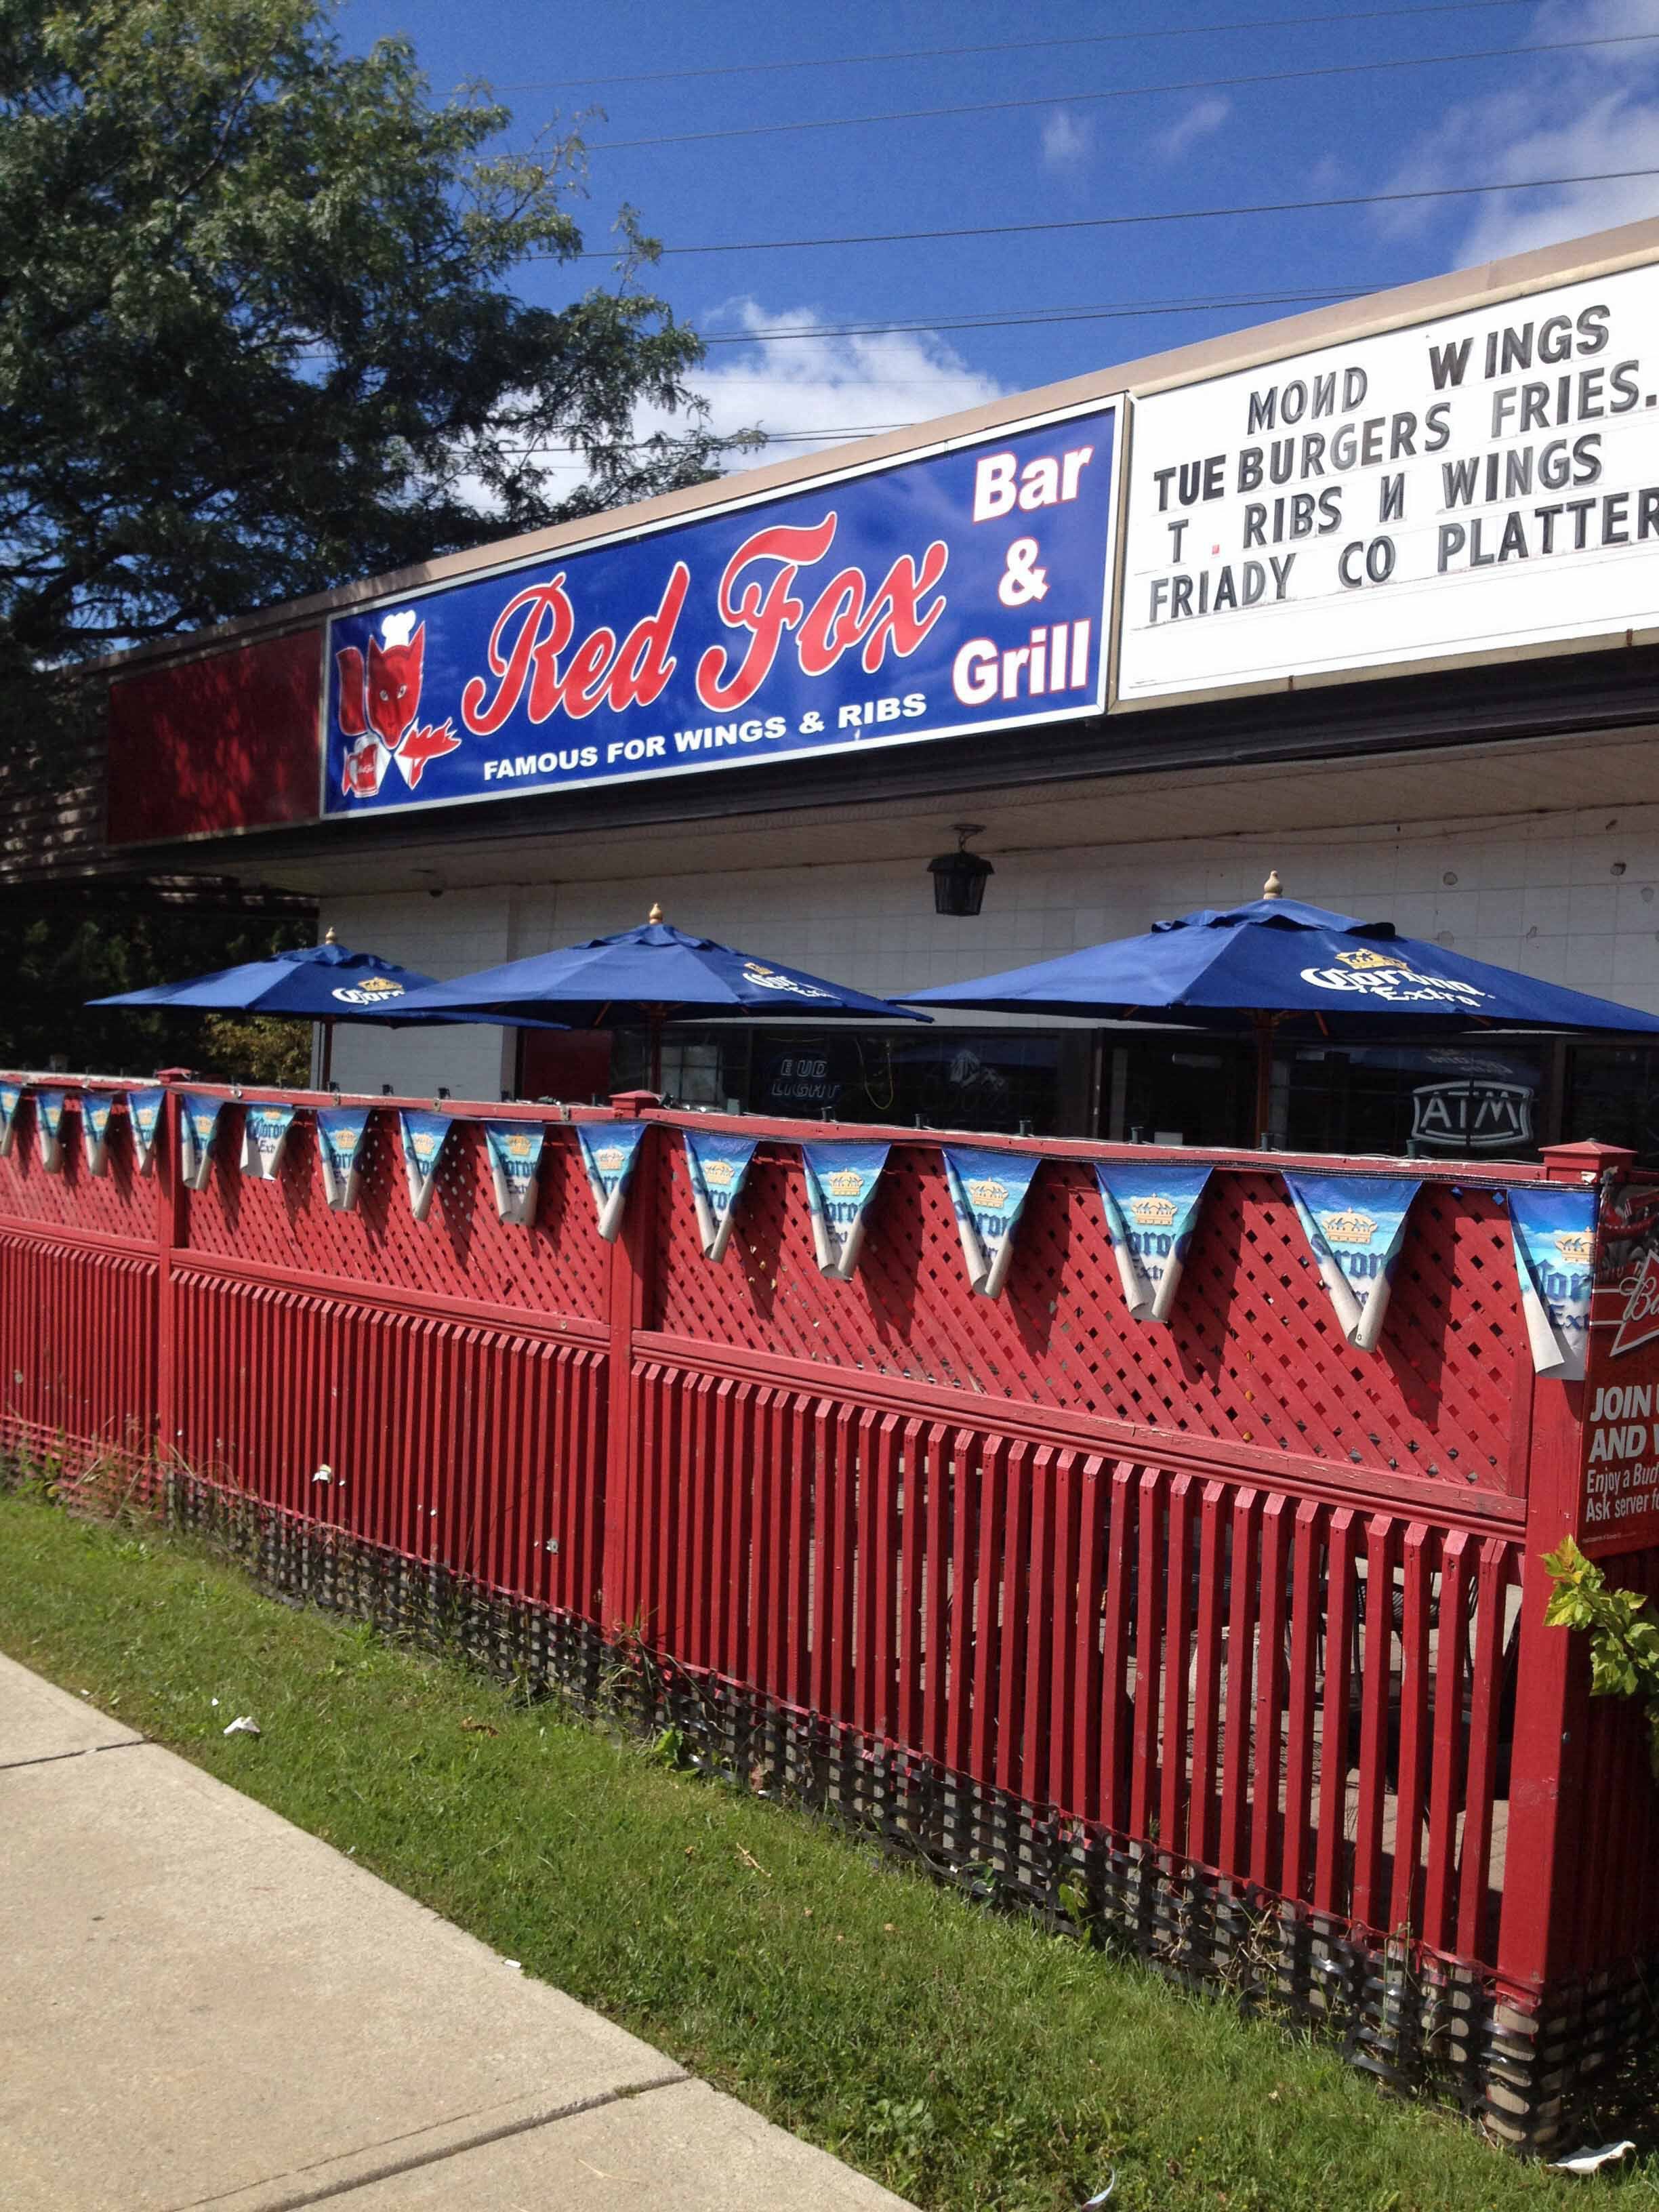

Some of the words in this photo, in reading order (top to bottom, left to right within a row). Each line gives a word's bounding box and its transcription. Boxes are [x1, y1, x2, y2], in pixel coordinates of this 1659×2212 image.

[1429, 304, 1610, 390] WINGS
[1153, 454, 1227, 512] TUE
[1237, 402, 1451, 493] BURGERS
[1491, 360, 1657, 438] FRIES.
[970, 445, 1093, 523] Bar
[1243, 486, 1343, 549] RIBS
[1442, 433, 1602, 509] WINGS
[997, 538, 1048, 607] &
[1149, 552, 1296, 623] FRIADY
[1338, 535, 1396, 588] CO
[462, 561, 691, 735] Red
[696, 511, 948, 713] Fox
[952, 619, 1091, 707] Grill
[483, 747, 598, 781] FAMOUS
[607, 735, 665, 766] FOR
[674, 717, 786, 752] WINGS
[798, 711, 825, 735] &
[837, 693, 927, 729] RIBS
[1420, 1091, 1519, 1128] ATM
[1589, 1425, 1647, 1463] AND
[1590, 1385, 1652, 1422] JOIN
[1586, 1495, 1610, 1523] Ask
[1614, 1494, 1649, 1518] server
[1587, 1467, 1621, 1496] Enjoy
[1623, 1469, 1630, 1488] a
[1633, 1461, 1659, 1486] Bud
